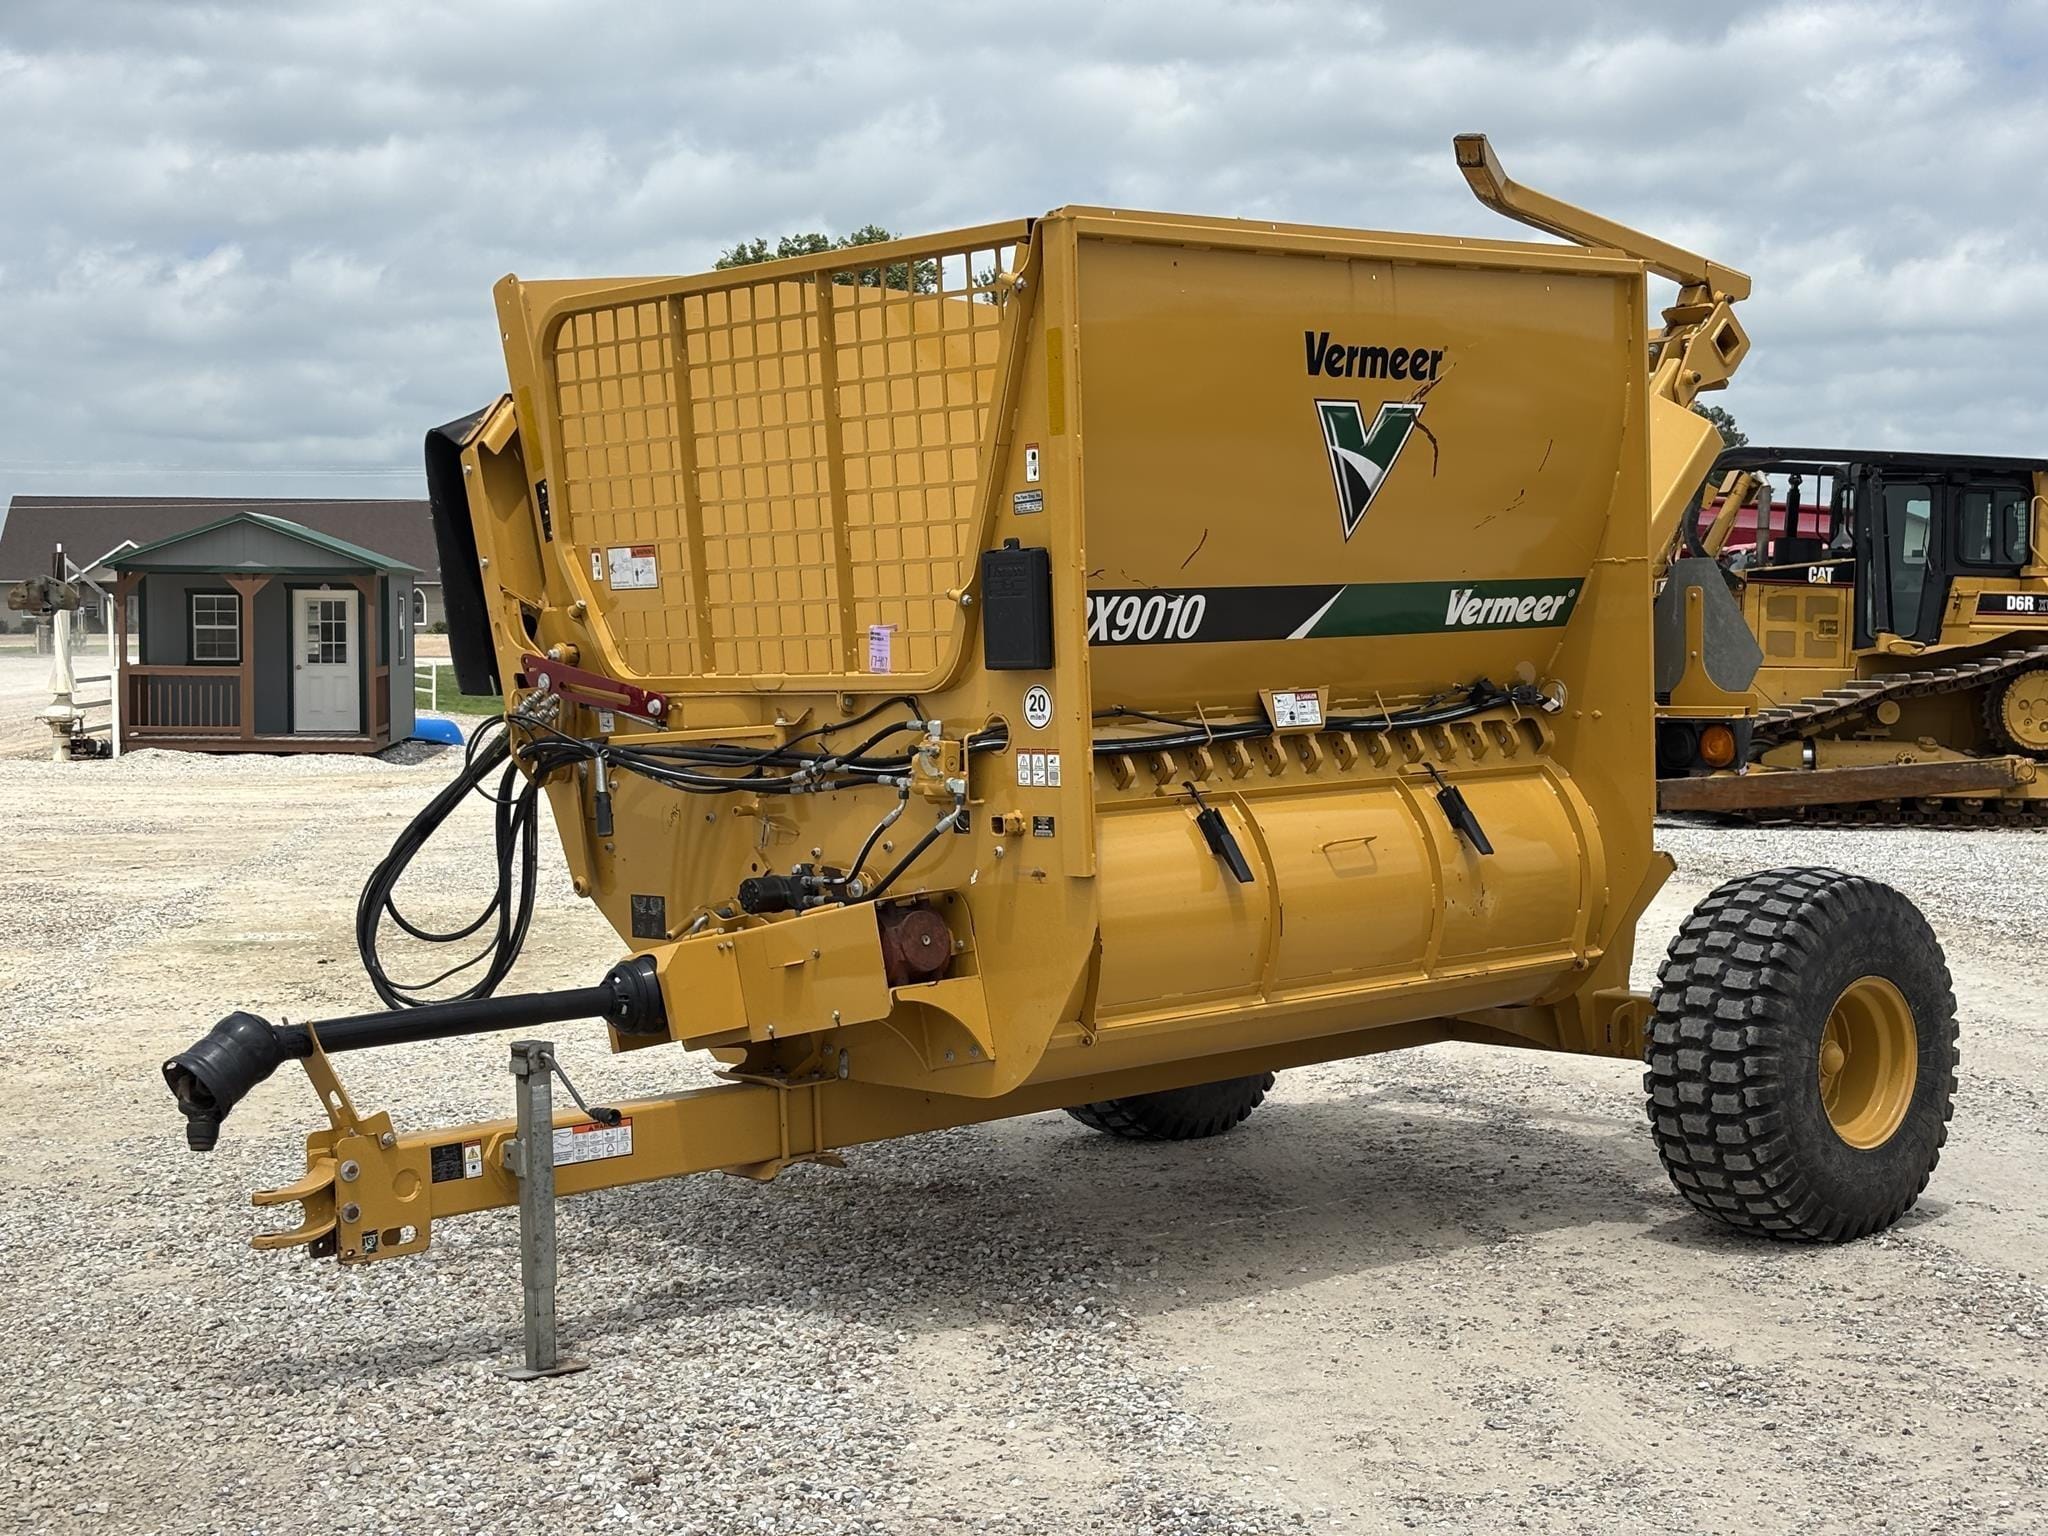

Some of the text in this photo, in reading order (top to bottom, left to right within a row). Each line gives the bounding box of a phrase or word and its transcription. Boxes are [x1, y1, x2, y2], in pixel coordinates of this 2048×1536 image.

[1305, 331, 1443, 381] Vermeer
[1808, 566, 1834, 585] CAT
[1445, 588, 1566, 626] Vermeer
[2006, 595, 2034, 611] D6R
[1029, 694, 1046, 712] 20
